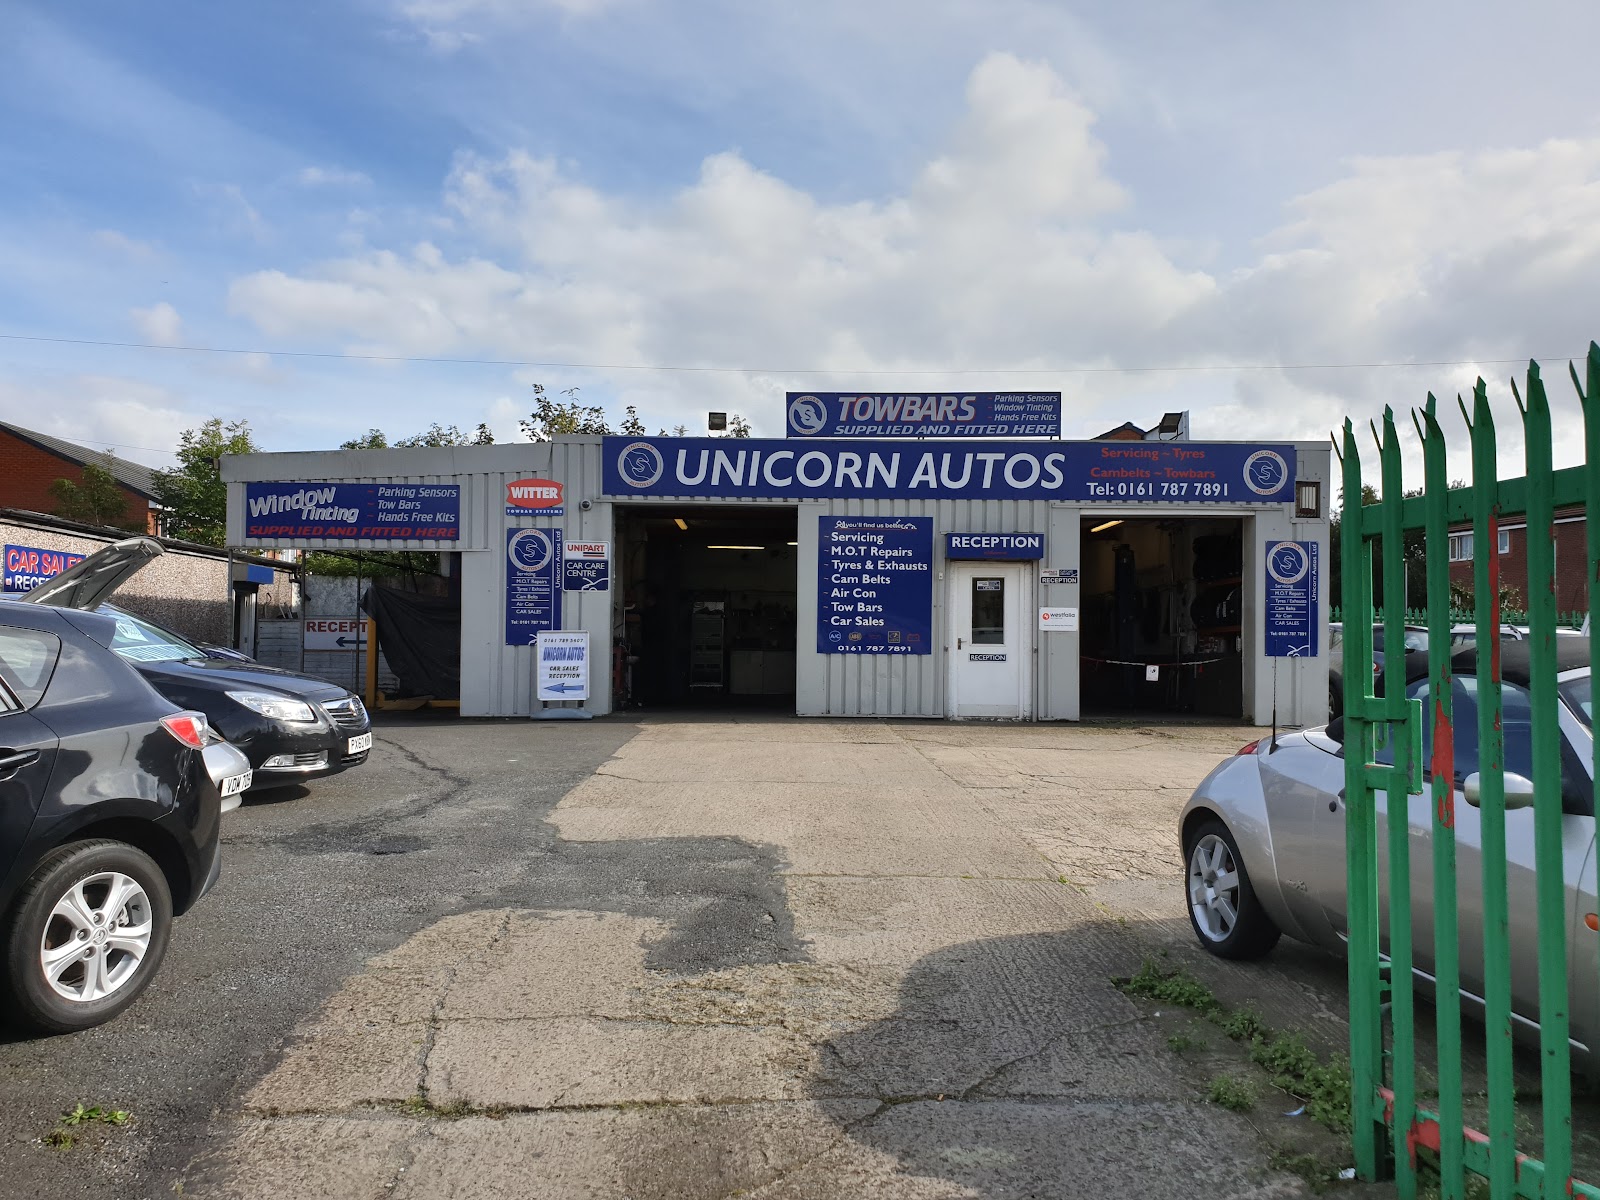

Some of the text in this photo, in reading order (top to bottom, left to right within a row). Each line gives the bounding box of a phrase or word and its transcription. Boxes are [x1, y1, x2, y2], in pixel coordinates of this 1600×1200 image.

[994, 394, 1024, 403] Parking
[838, 396, 976, 421] TOWBARS
[994, 403, 1053, 412] Window Tinting
[994, 412, 1057, 421] Hands Free Kits
[834, 425, 1058, 435] SUPPLIED AND FITTED HERE
[1101, 447, 1159, 460] Servicing
[1172, 448, 1205, 460] Tyres
[675, 449, 1066, 490] UNICORN AUTOS
[1090, 467, 1150, 478] Cambelts
[1164, 468, 1216, 479] Towbars
[378, 487, 457, 498] Parking Sensors
[511, 487, 558, 499] WITTER
[1086, 482, 1228, 496] Tel: 0161 787 7891
[249, 487, 337, 518] Window
[378, 500, 421, 510] Tow Bars
[301, 505, 359, 523] Tinting
[378, 512, 456, 523] Hands Free Kits
[249, 526, 457, 538] SUPPLIED AND FITTED HERE
[831, 532, 884, 545] Servicing
[952, 536, 1039, 548] RECEPTION
[567, 544, 605, 552] UNIPART
[831, 546, 913, 559] M.O.T Repairs
[7, 549, 83, 575] CAR SALE
[585, 562, 605, 570] CARE
[831, 560, 928, 572] Tyres & Exhausts
[566, 569, 597, 577] CENTRE
[831, 574, 891, 584] Cam Belts
[14, 574, 50, 590] RECE
[831, 588, 876, 598] Air Con
[831, 602, 883, 612] Tow Bars
[831, 616, 884, 626] Car Sales
[543, 647, 585, 661] UNICORN AUTOS
